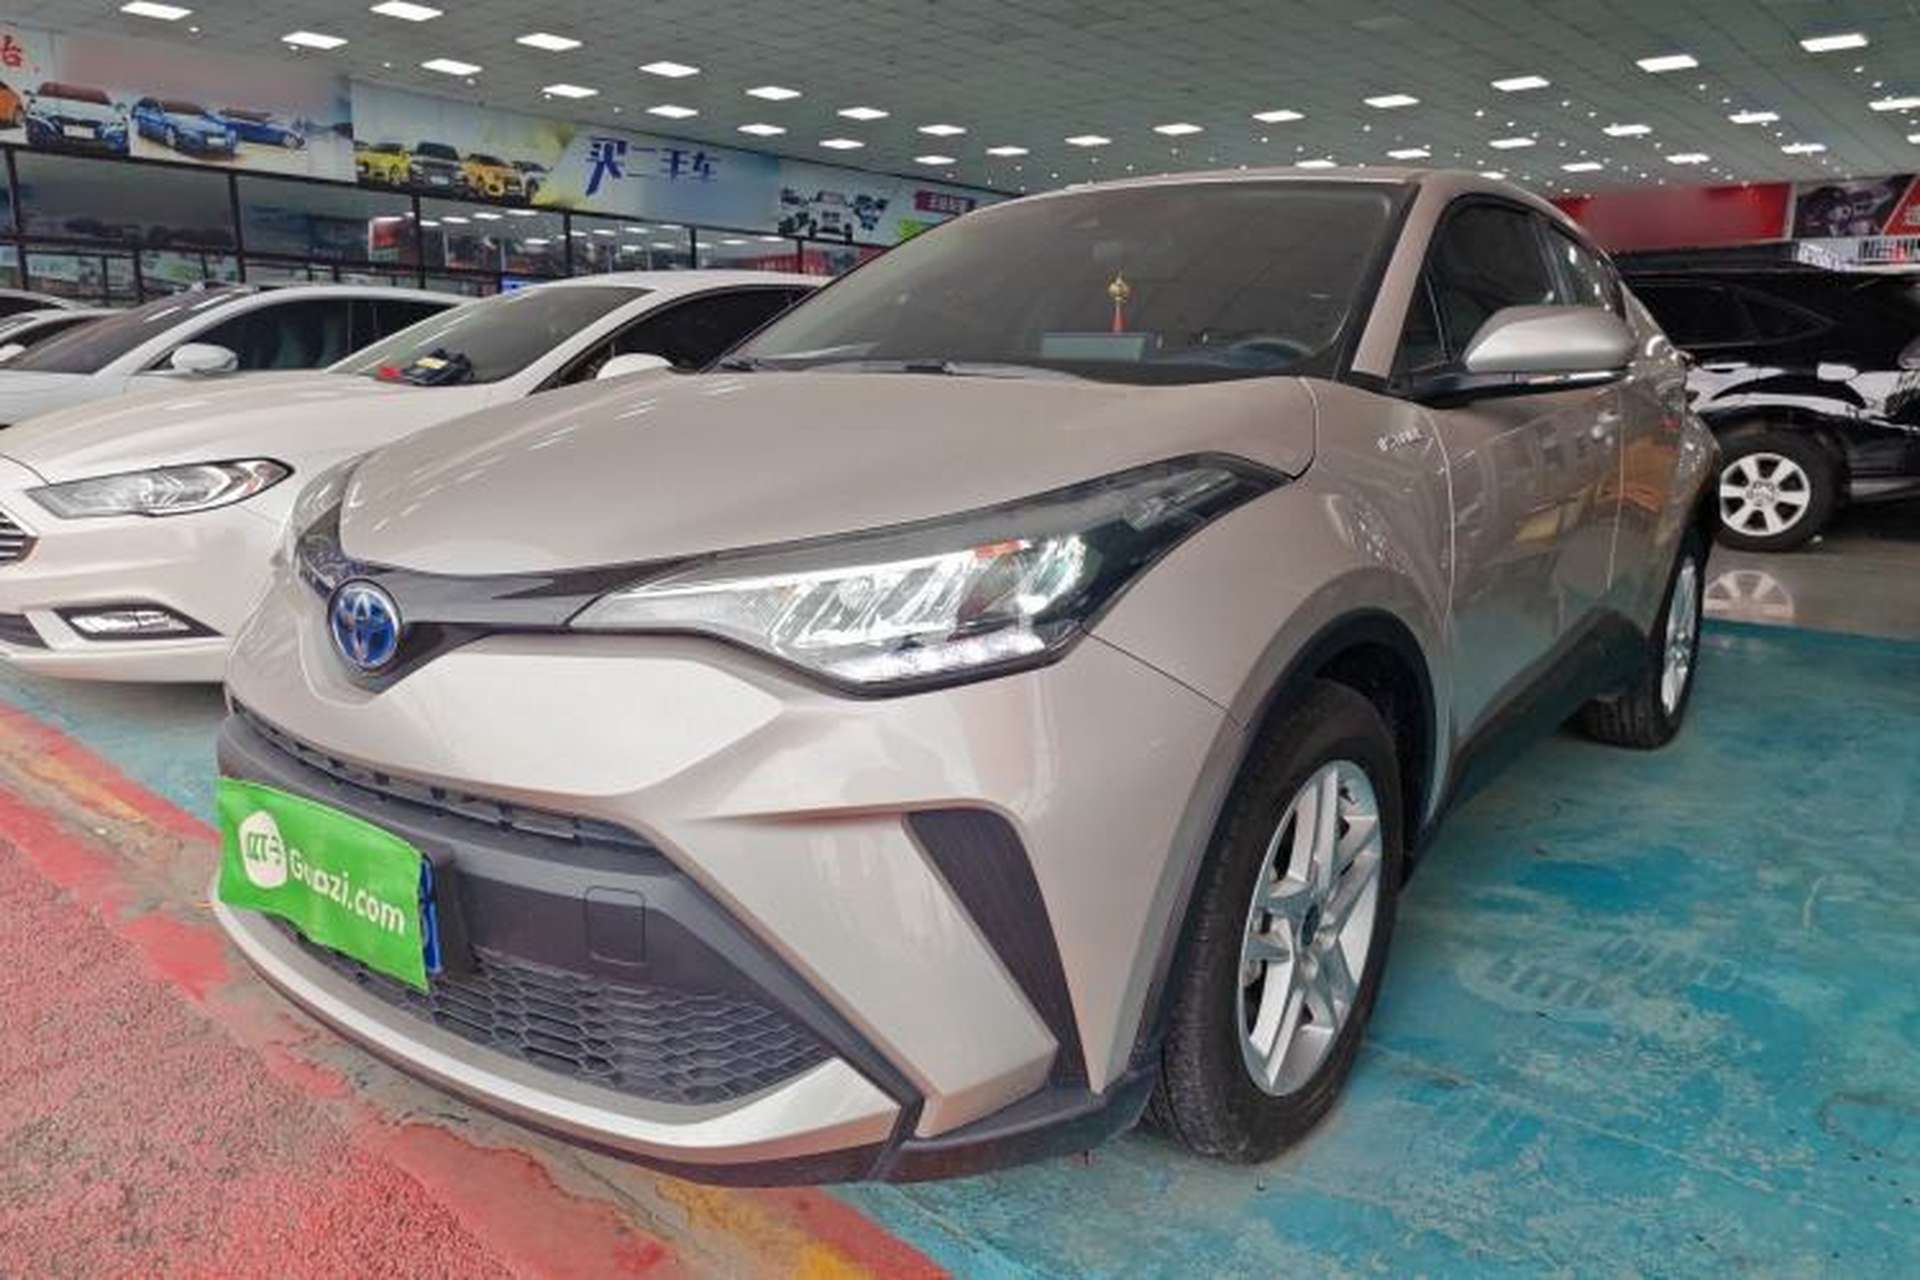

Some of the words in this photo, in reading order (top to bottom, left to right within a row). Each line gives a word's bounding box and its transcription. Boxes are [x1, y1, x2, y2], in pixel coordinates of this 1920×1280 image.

[586, 137, 720, 197] 买二手车
[289, 850, 405, 934] Guazi.com
